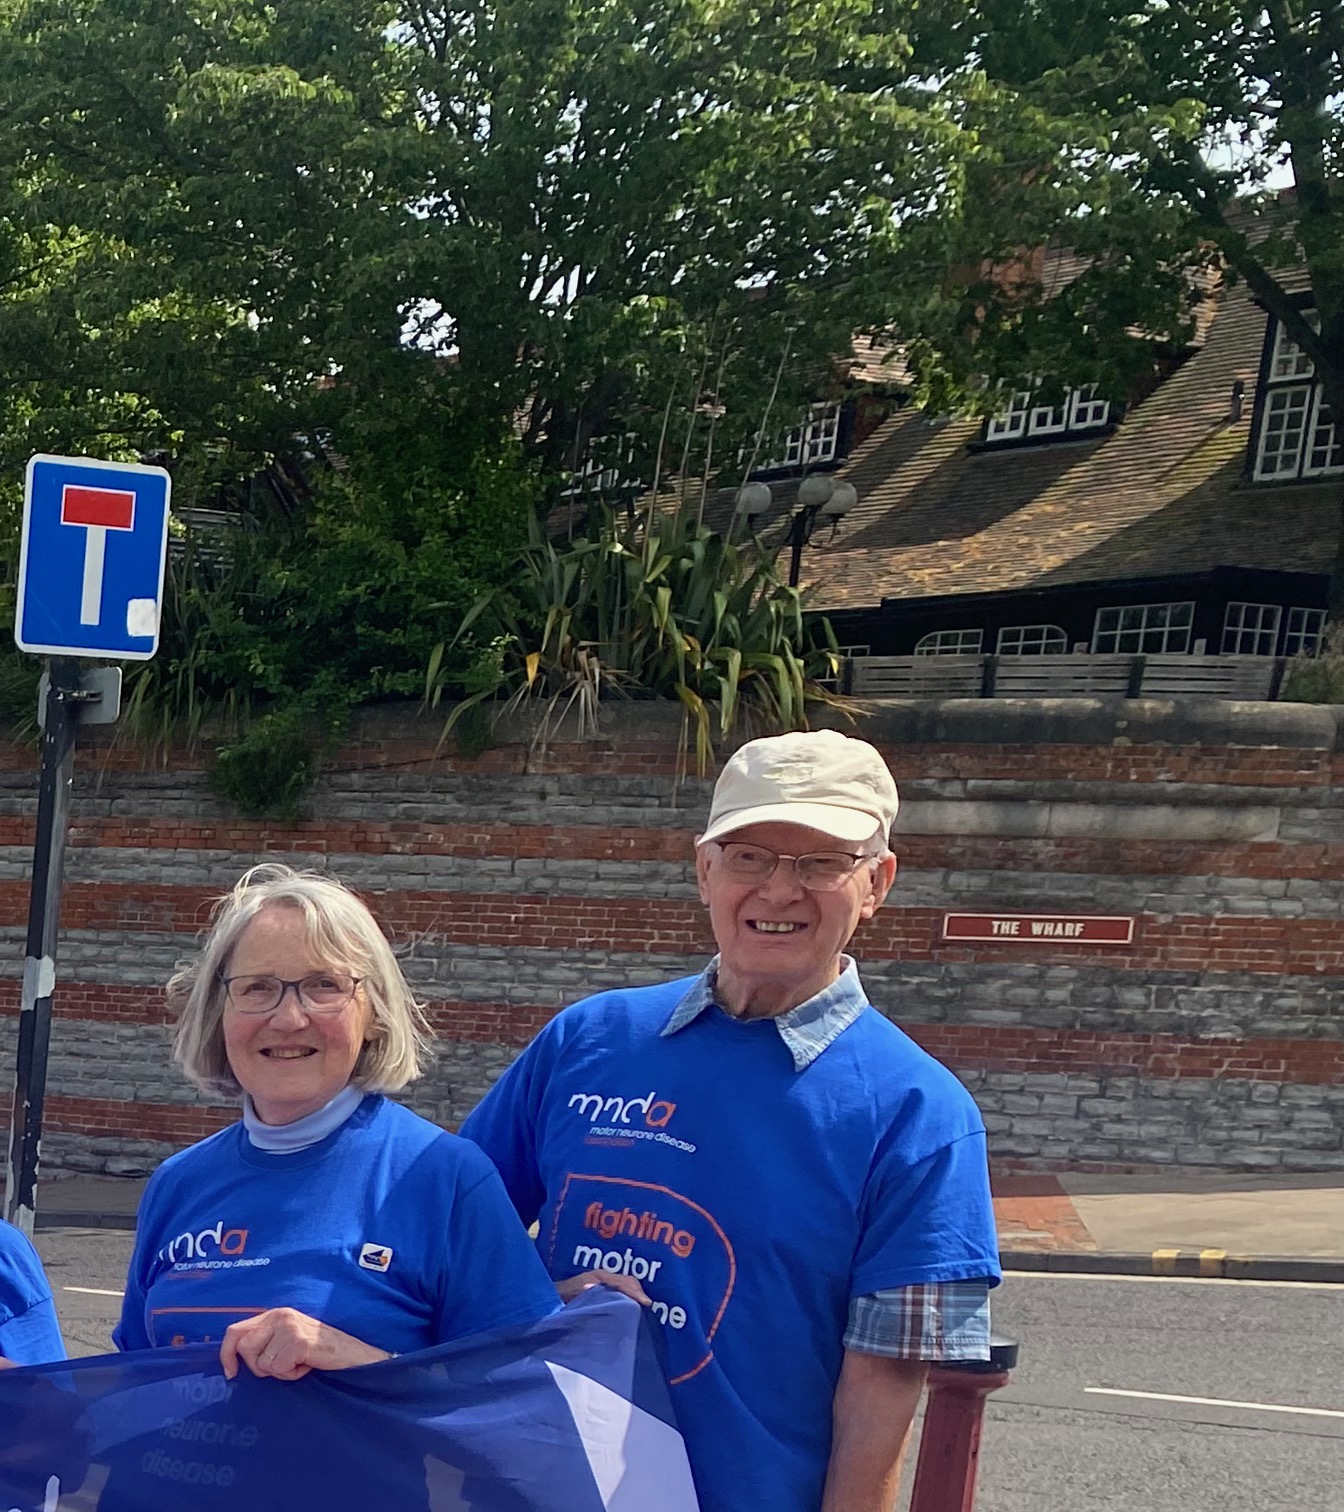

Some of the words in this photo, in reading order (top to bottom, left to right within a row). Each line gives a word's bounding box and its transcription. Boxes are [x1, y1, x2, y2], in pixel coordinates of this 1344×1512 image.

[991, 920, 1021, 935] THE
[1031, 921, 1085, 937] WHARF
[568, 1091, 677, 1127] mnda
[654, 1132, 697, 1154] disease
[584, 1201, 697, 1259] fighting
[572, 1244, 662, 1283] motor
